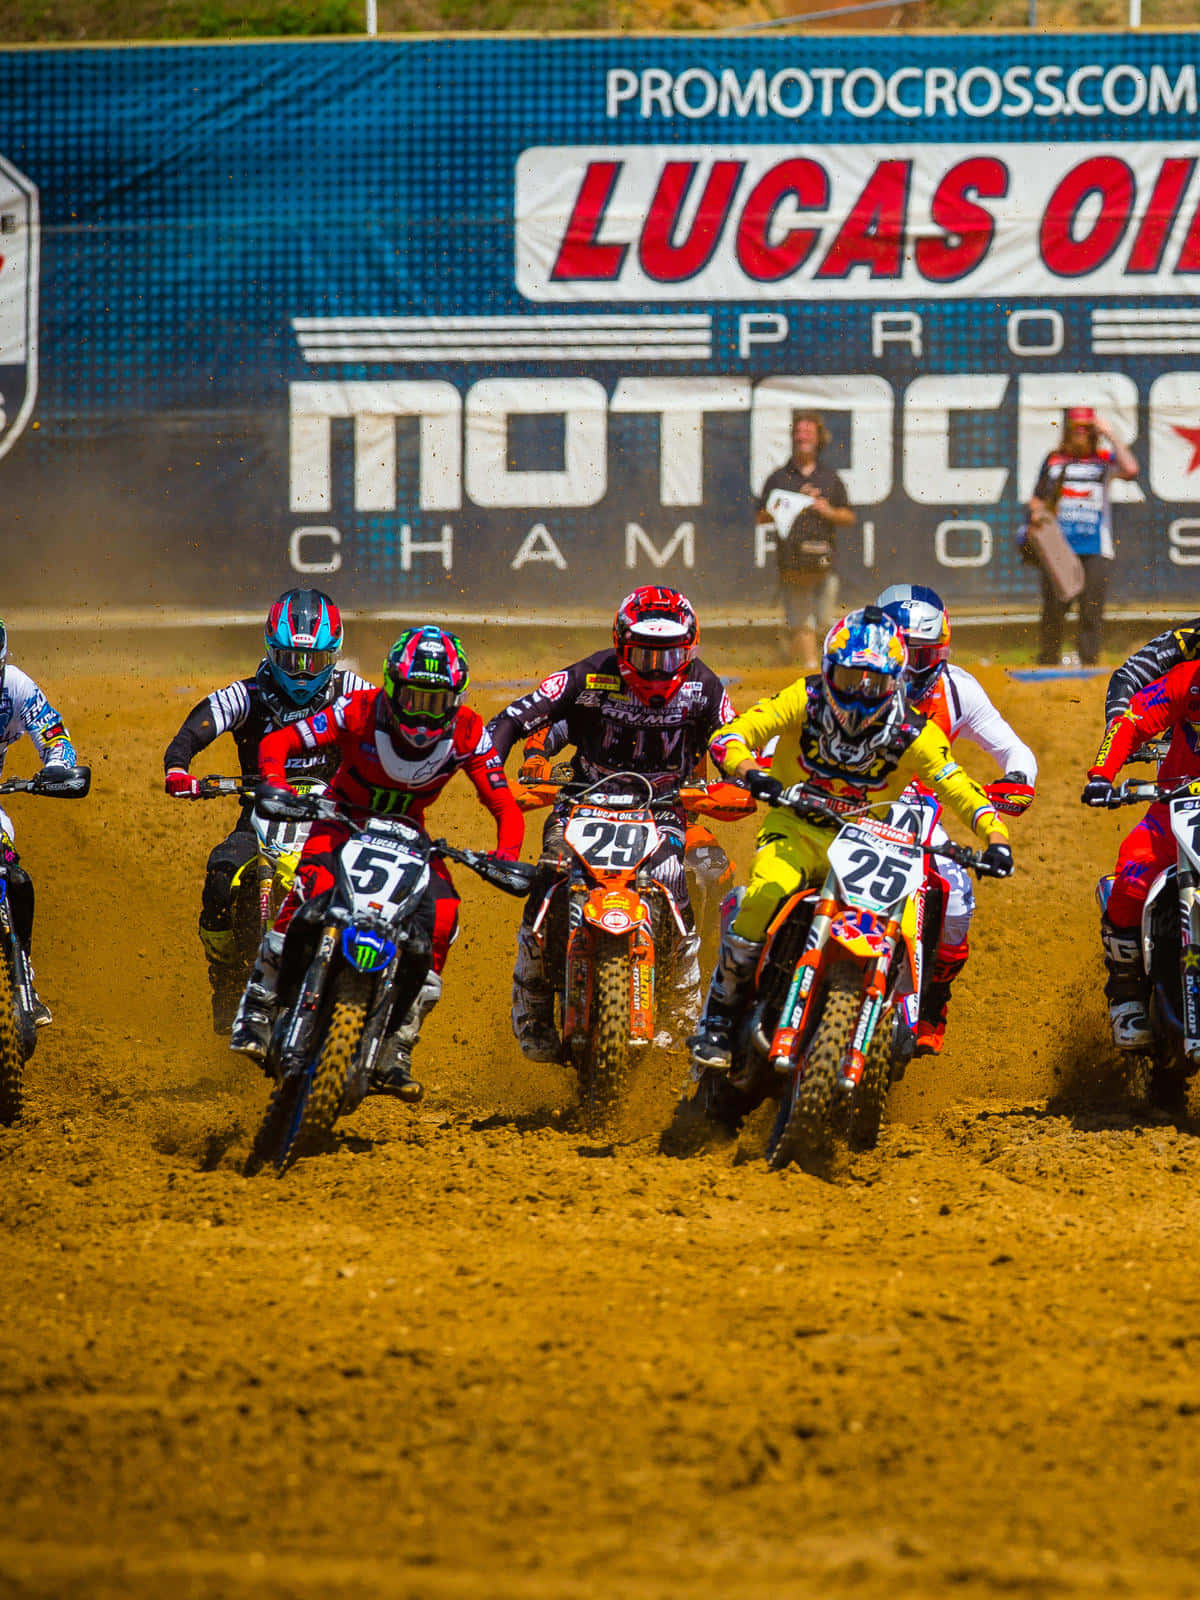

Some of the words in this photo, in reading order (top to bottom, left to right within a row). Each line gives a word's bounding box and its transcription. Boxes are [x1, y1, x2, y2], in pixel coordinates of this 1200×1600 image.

[606, 64, 1198, 119] PROMOTOCROSS.COM
[549, 155, 1010, 284] LUCAS
[739, 309, 1064, 359] PRO
[371, 838, 398, 850] LUCAS
[582, 822, 648, 866] 29
[349, 847, 422, 903] 51
[841, 849, 912, 903] 25
[791, 965, 815, 1030] DUNOP
